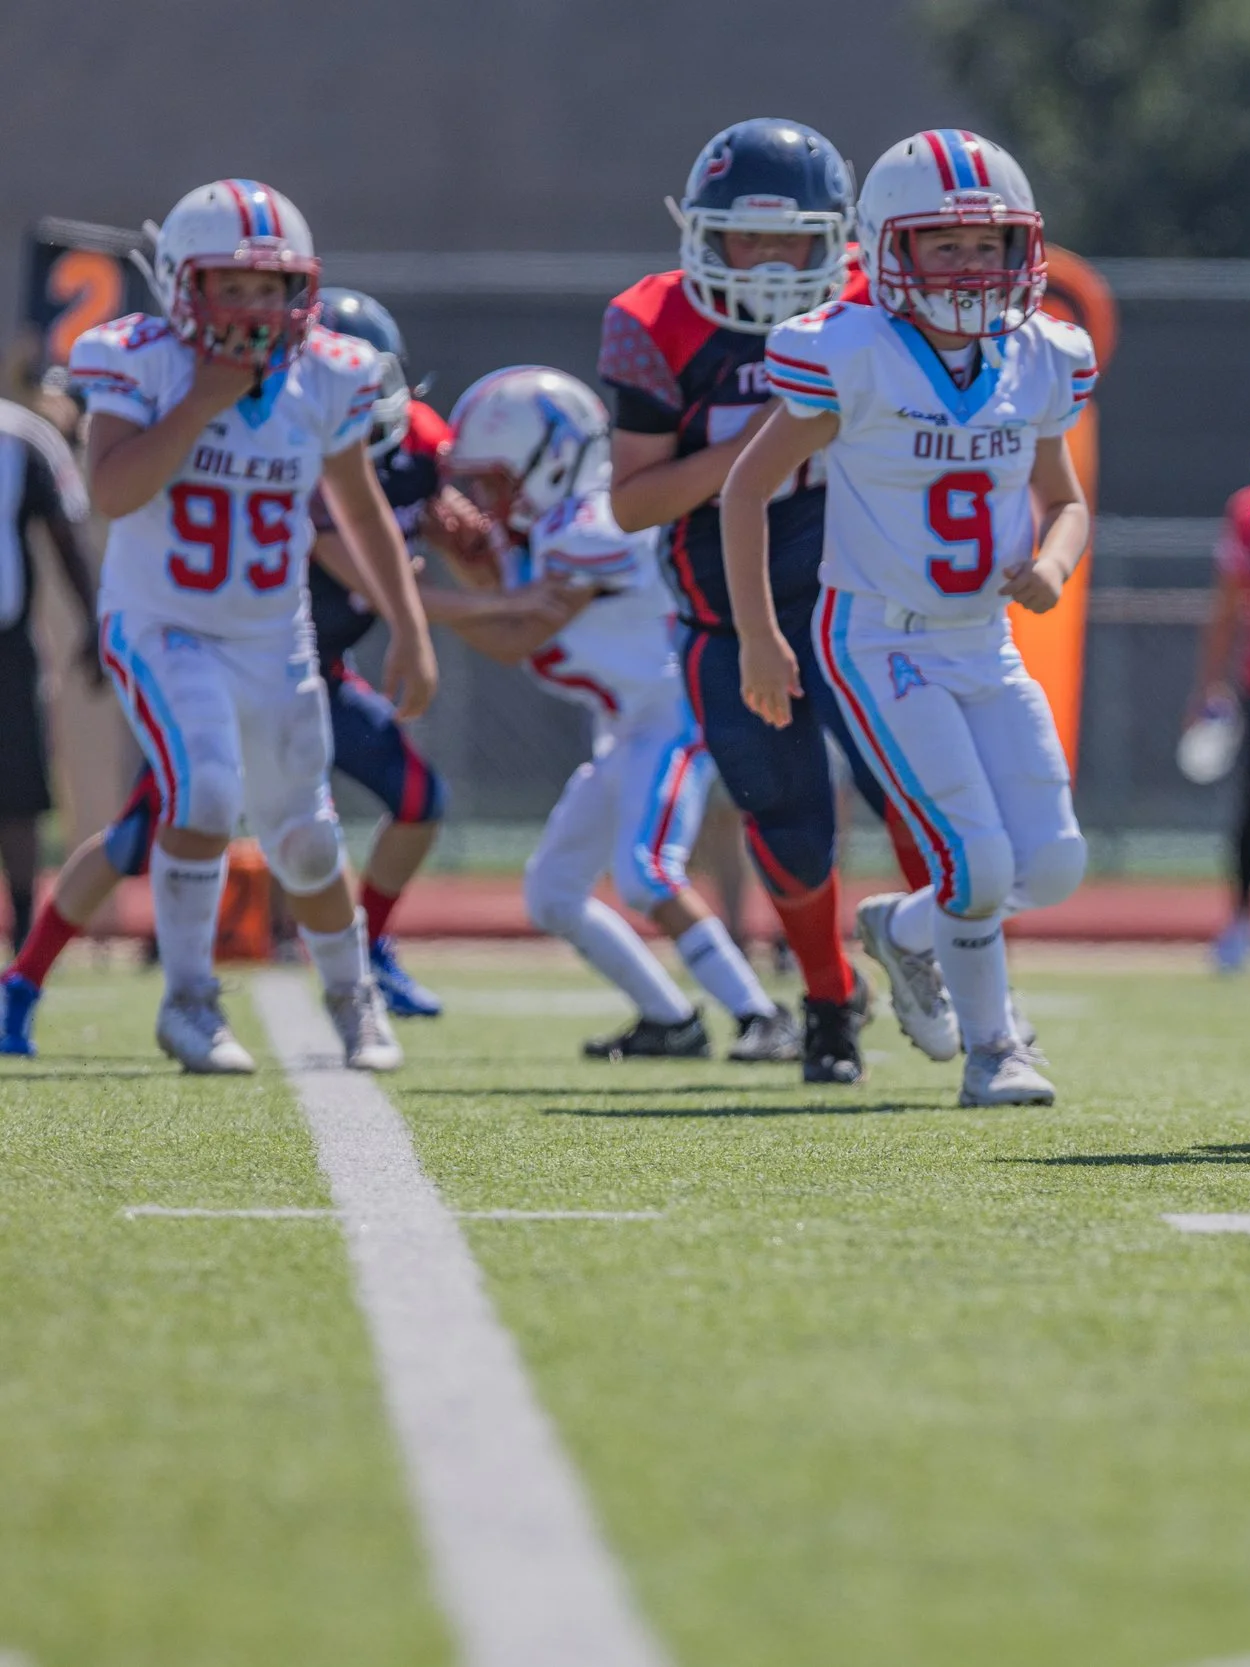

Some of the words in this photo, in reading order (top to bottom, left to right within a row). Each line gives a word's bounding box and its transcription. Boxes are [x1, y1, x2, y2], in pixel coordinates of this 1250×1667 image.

[914, 429, 1022, 461] OILERS
[194, 446, 299, 482] OILERS
[925, 468, 998, 597] 9
